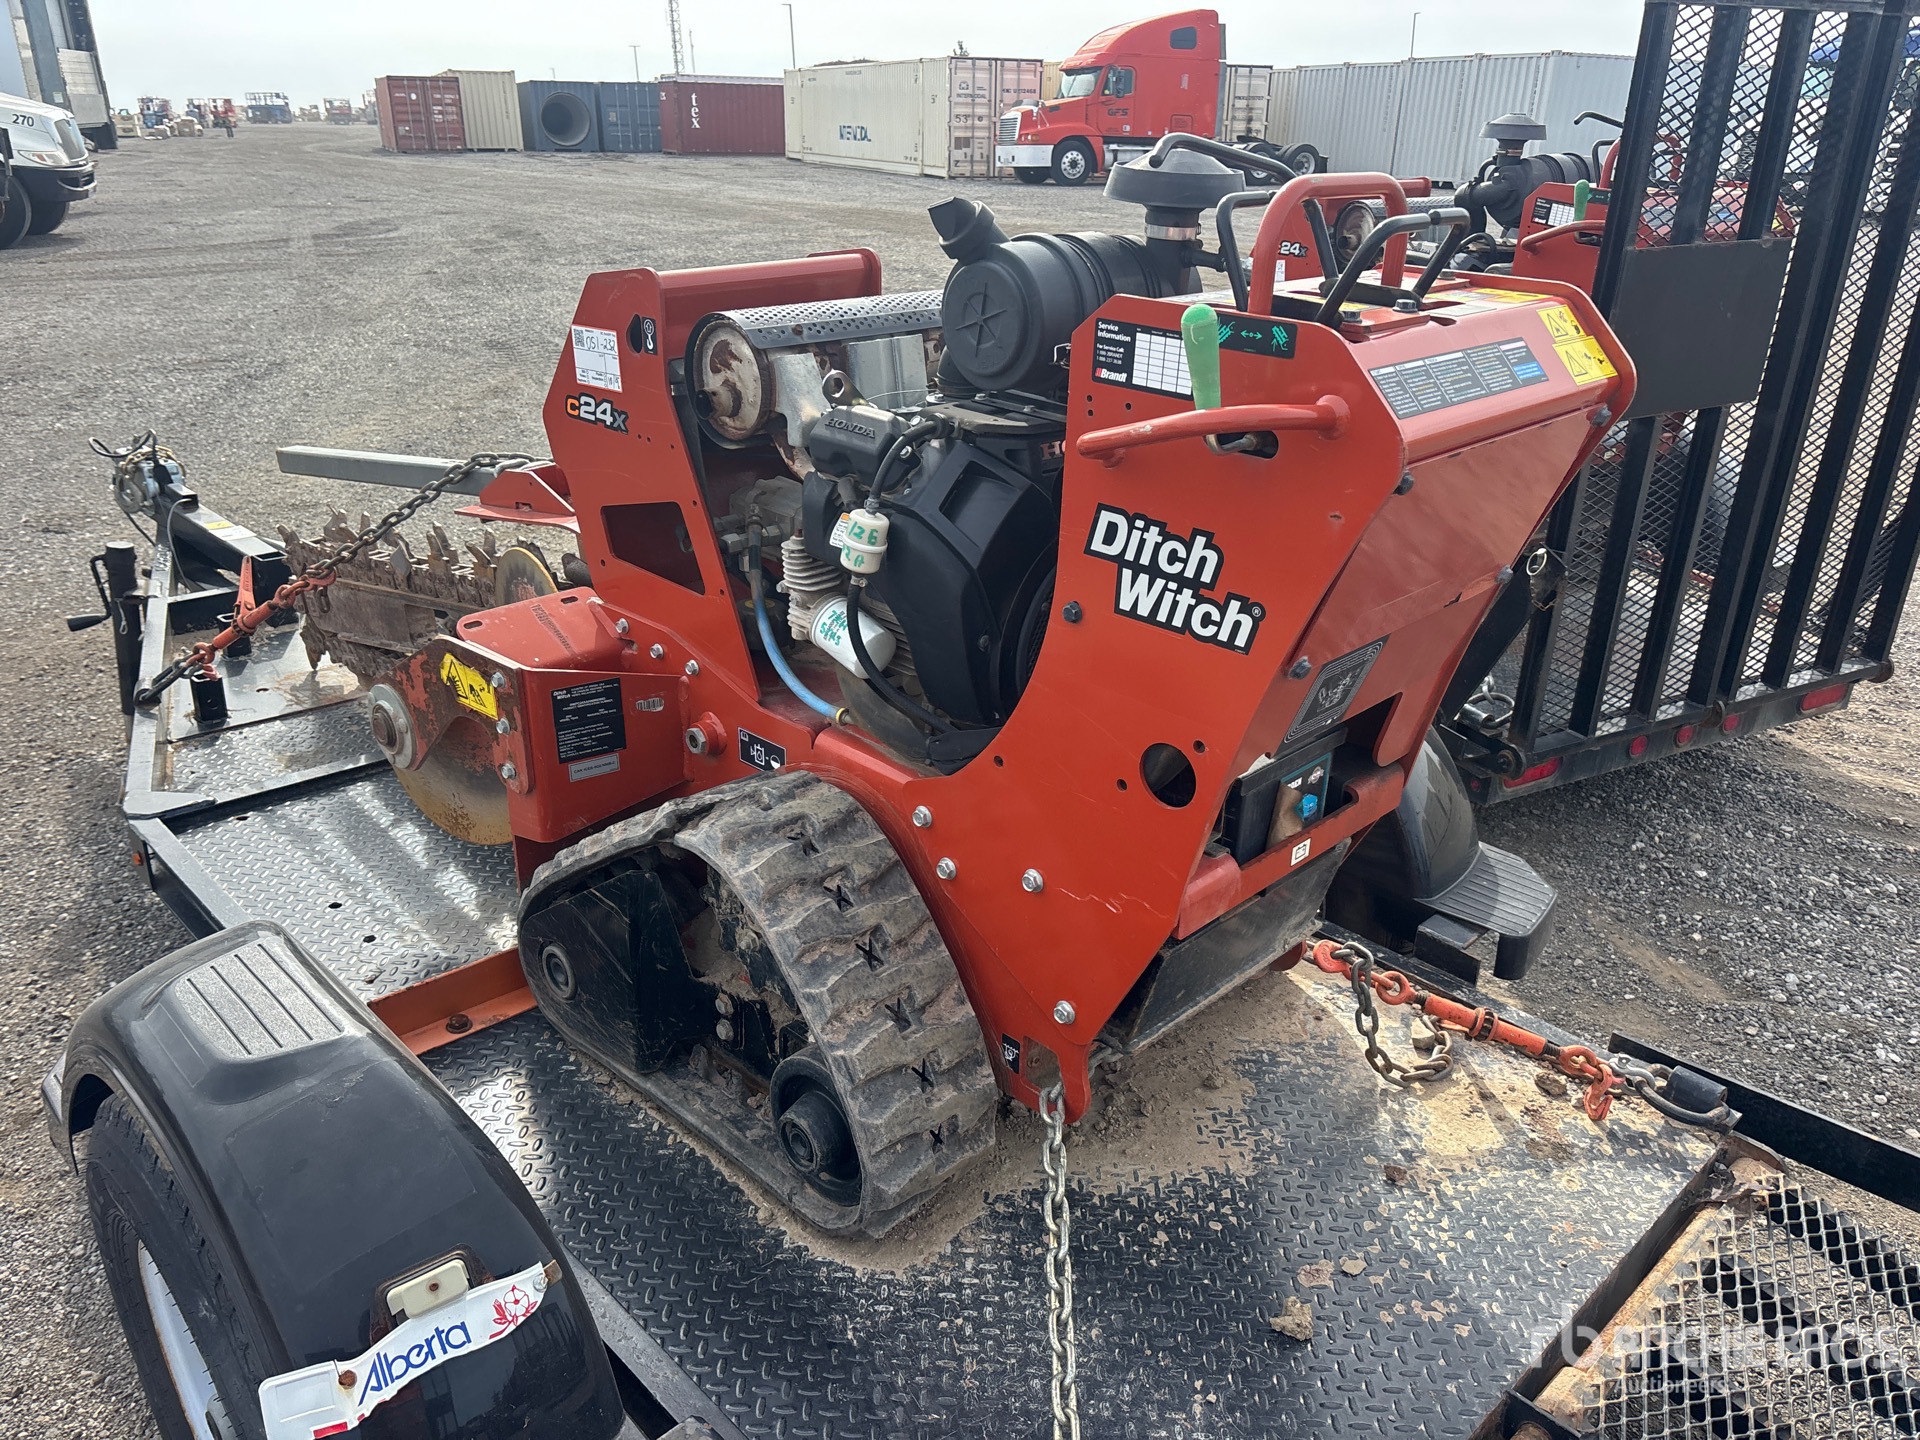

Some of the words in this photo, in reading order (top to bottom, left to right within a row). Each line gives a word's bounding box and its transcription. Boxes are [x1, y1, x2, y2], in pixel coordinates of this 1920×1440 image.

[690, 92, 701, 129] tex
[1107, 107, 1129, 117] GFS
[12, 113, 35, 127] 270
[1097, 320, 1119, 332] Service
[1097, 329, 1132, 343] Information
[1100, 368, 1128, 383] Brandt
[824, 416, 876, 439] HONDA
[1090, 509, 1219, 584] Ditch
[357, 1320, 472, 1408] Alberta
